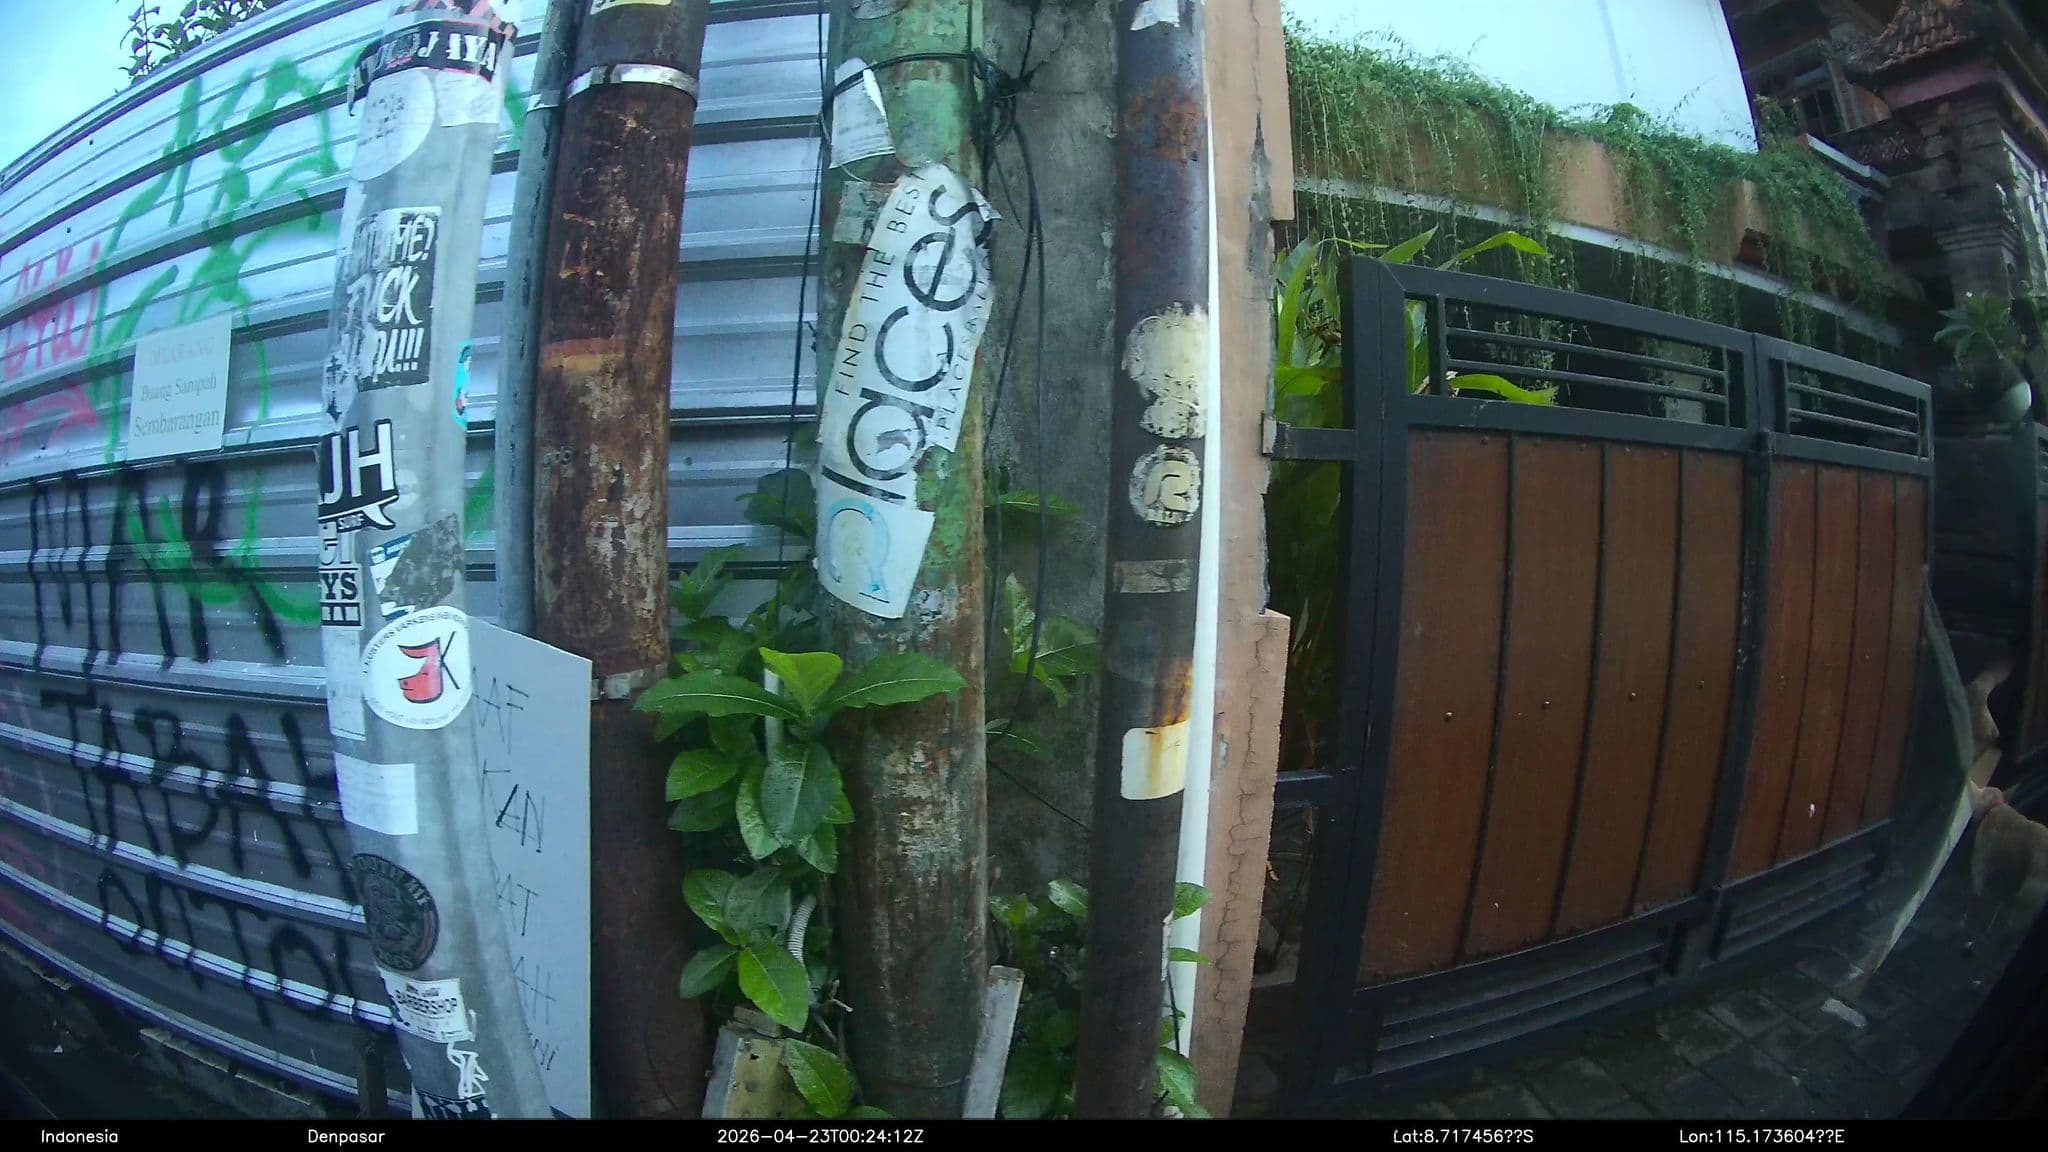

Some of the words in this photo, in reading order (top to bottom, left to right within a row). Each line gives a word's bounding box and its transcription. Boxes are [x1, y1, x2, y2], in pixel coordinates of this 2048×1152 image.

[346, 264, 424, 326] FUCK
[834, 322, 868, 396] FIND
[861, 249, 896, 302] THE
[886, 171, 925, 234] BEST
[134, 409, 221, 438] Sembarangan
